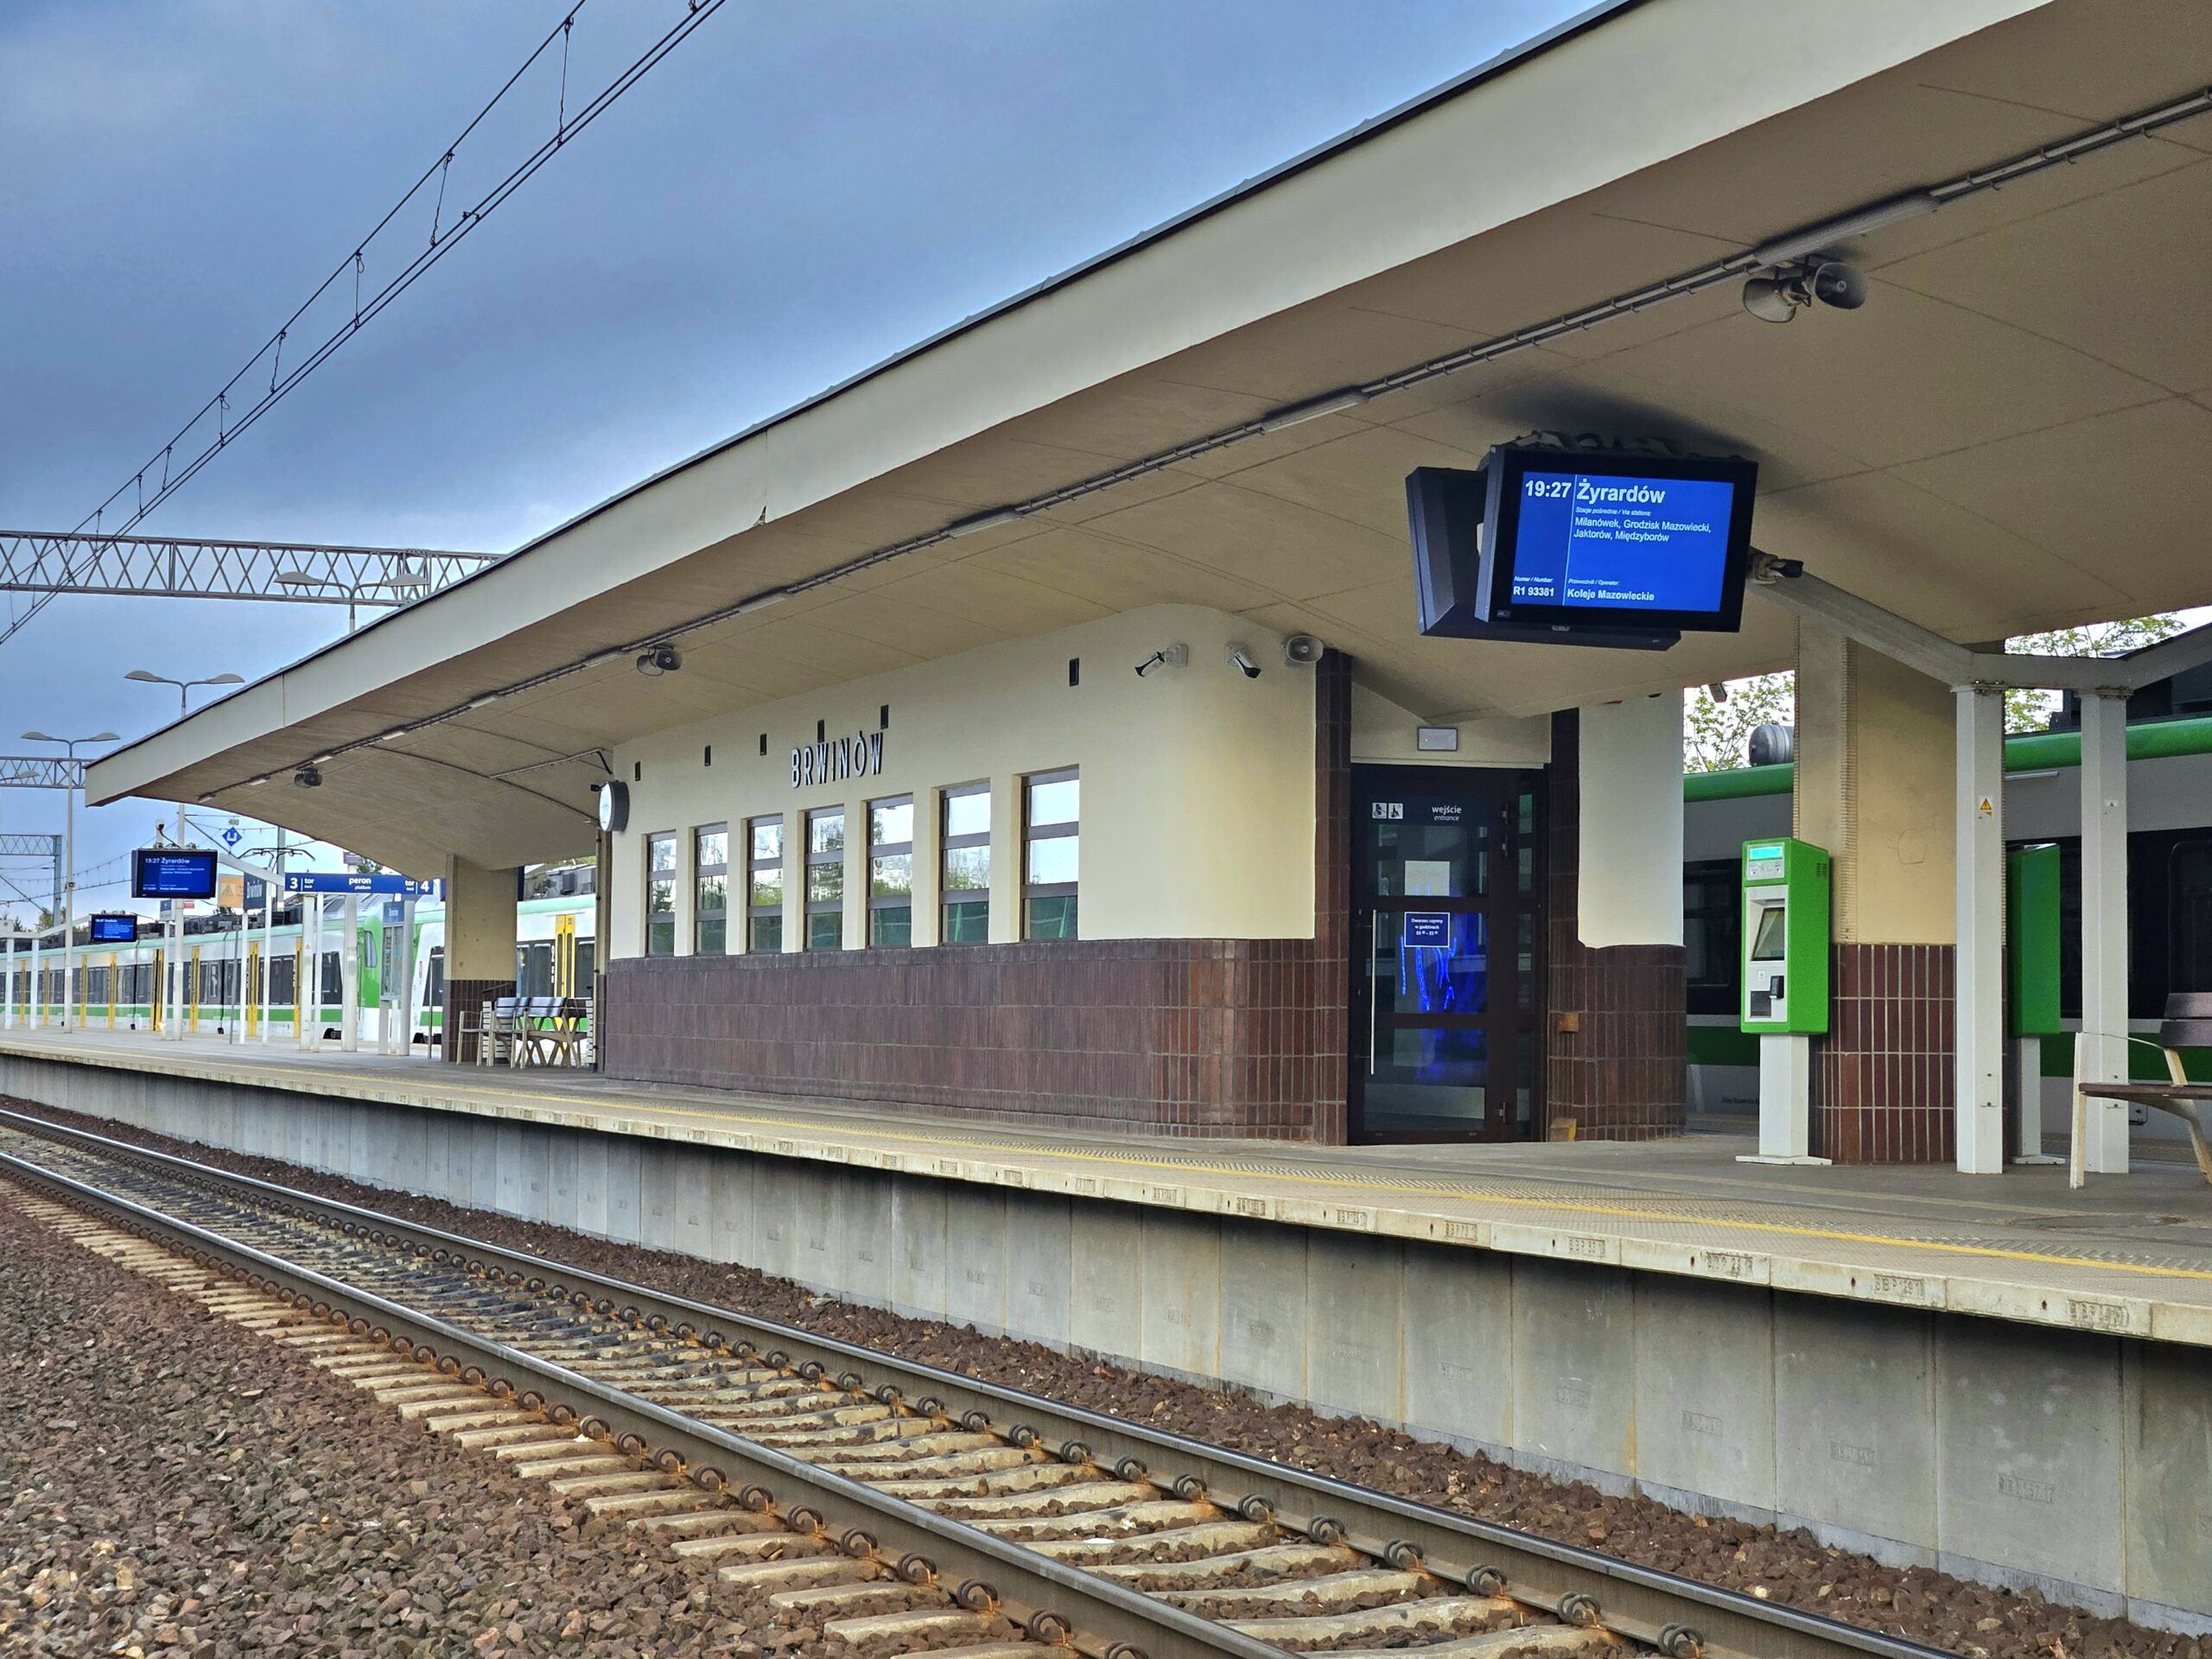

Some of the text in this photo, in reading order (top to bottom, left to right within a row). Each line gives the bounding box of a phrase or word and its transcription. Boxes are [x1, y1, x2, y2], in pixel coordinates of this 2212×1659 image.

[1525, 480, 1572, 499] 19:27
[1576, 478, 1666, 505] Żyrardów
[1575, 517, 1712, 533] Milanówek, Grodzisk Mazowiecki,
[1573, 529, 1670, 543] Jaktorów, Międzyborów
[1513, 586, 1554, 597] R1 93381
[1567, 588, 1655, 601] Koleje Mazowieckie
[791, 730, 883, 789] BRWINÓW
[1432, 805, 1462, 815] wejście
[289, 877, 298, 889] 3
[420, 880, 430, 893] 4
